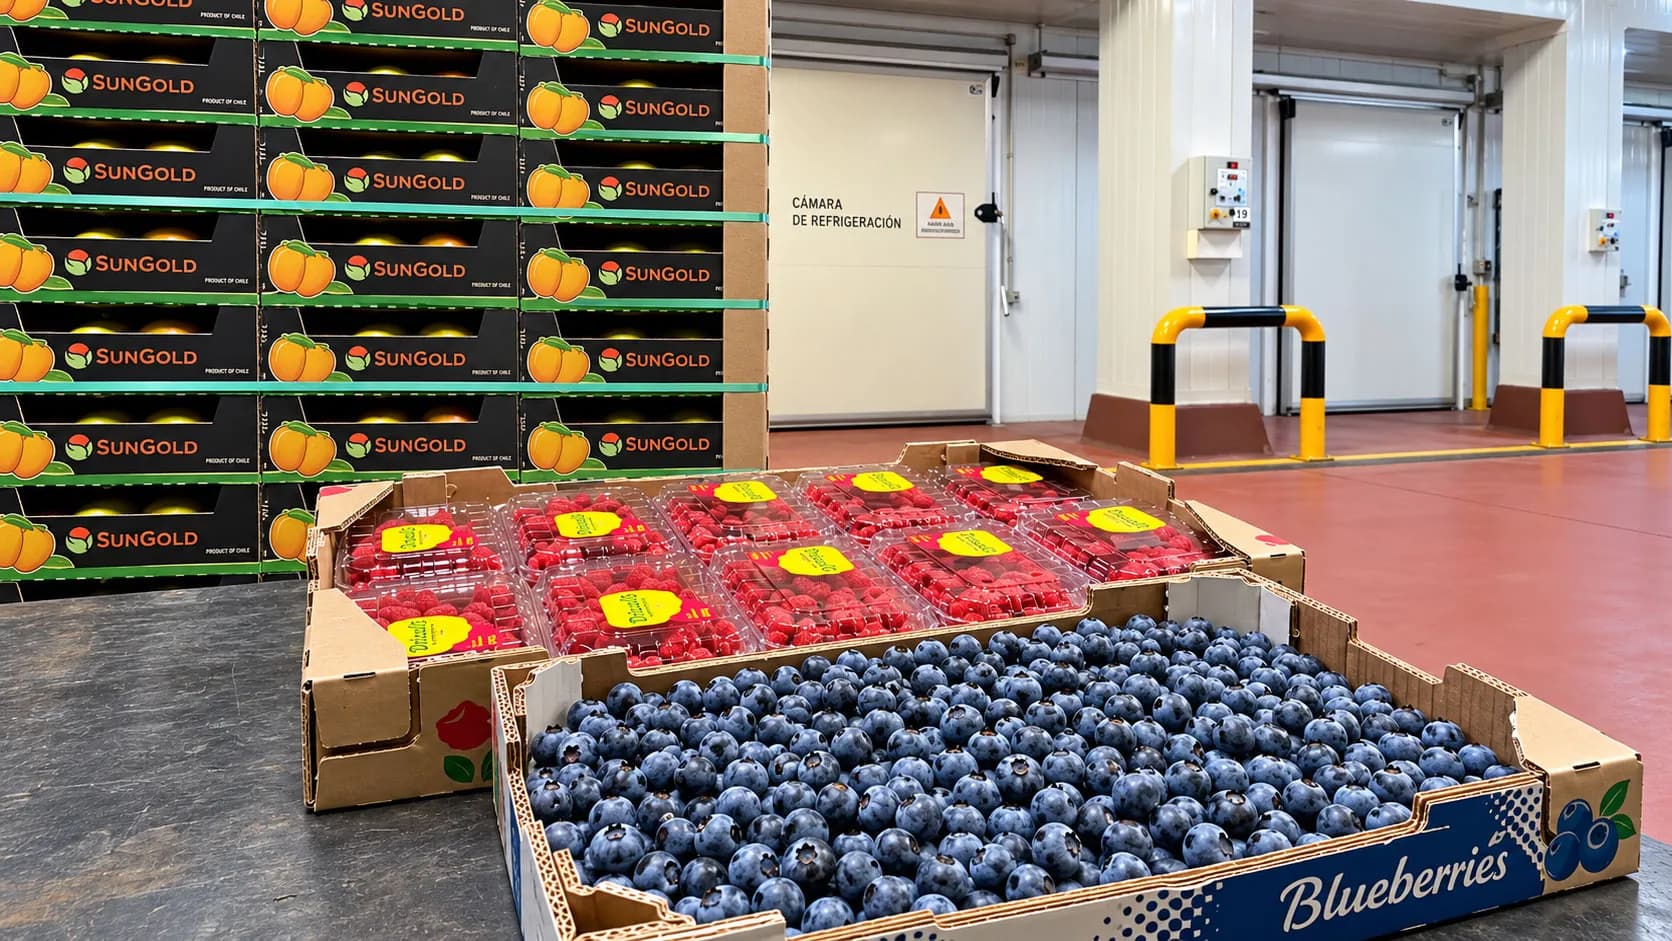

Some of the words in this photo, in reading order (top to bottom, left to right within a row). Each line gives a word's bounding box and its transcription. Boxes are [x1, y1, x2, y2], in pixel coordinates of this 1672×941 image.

[792, 194, 843, 211] CÁMARA
[792, 214, 808, 226] DE
[811, 214, 902, 229] REFRIGERACIÓN
[1237, 209, 1248, 219] 19
[1280, 846, 1508, 933] Blueberries
